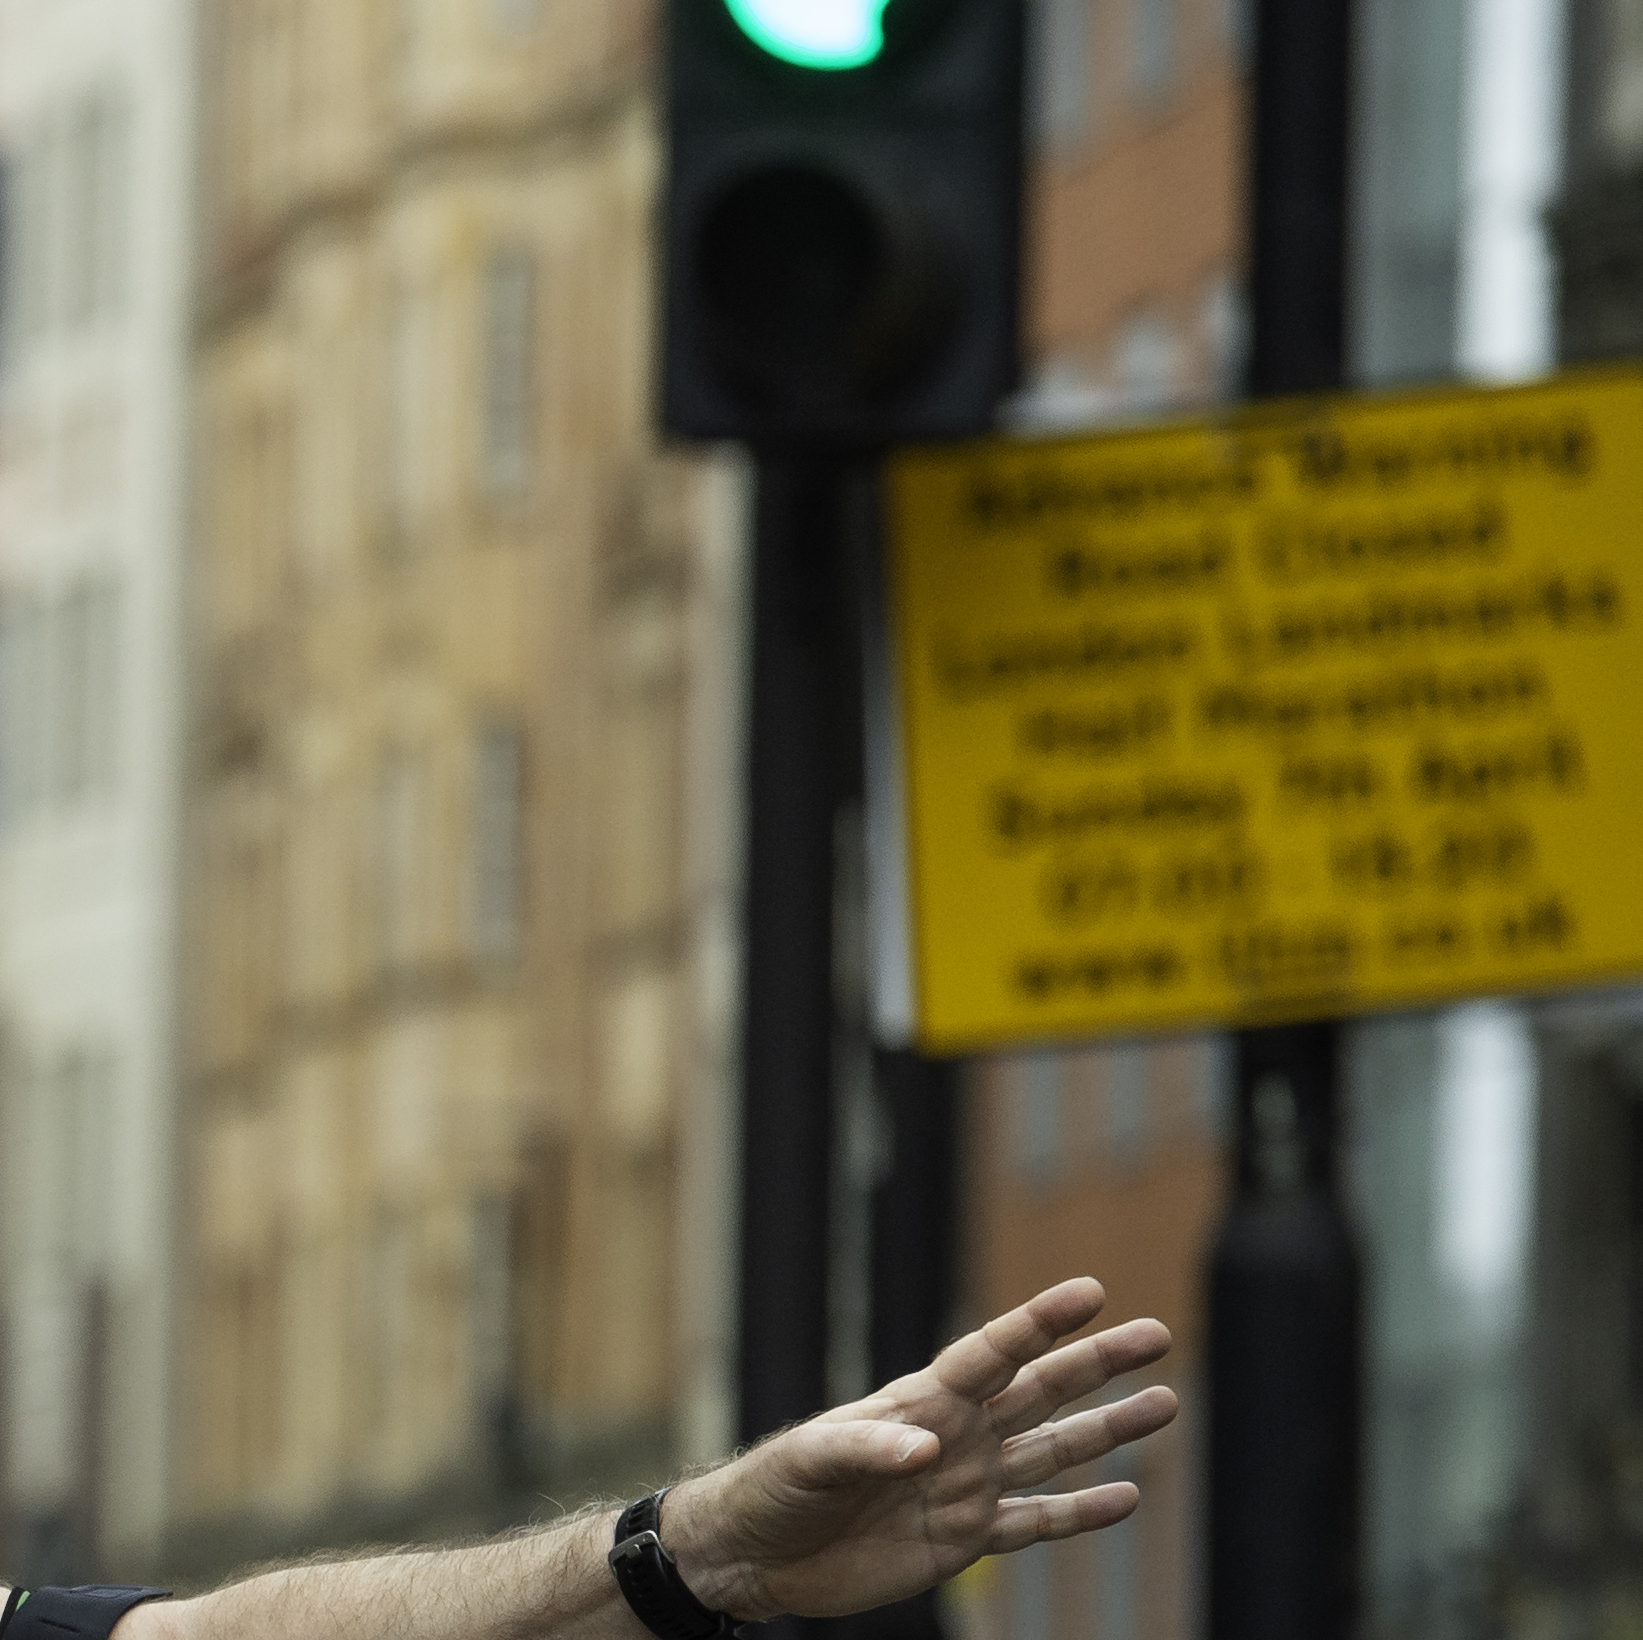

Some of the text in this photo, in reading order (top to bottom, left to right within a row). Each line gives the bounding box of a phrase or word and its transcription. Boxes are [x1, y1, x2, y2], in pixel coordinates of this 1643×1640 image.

[962, 417, 1592, 532] Advance Warning
[1050, 495, 1506, 598] Road Closed
[938, 572, 1622, 695] London Landmarks
[1024, 663, 1548, 762] Half Marathon
[985, 777, 1250, 854] Sunday
[1412, 727, 1583, 804] April
